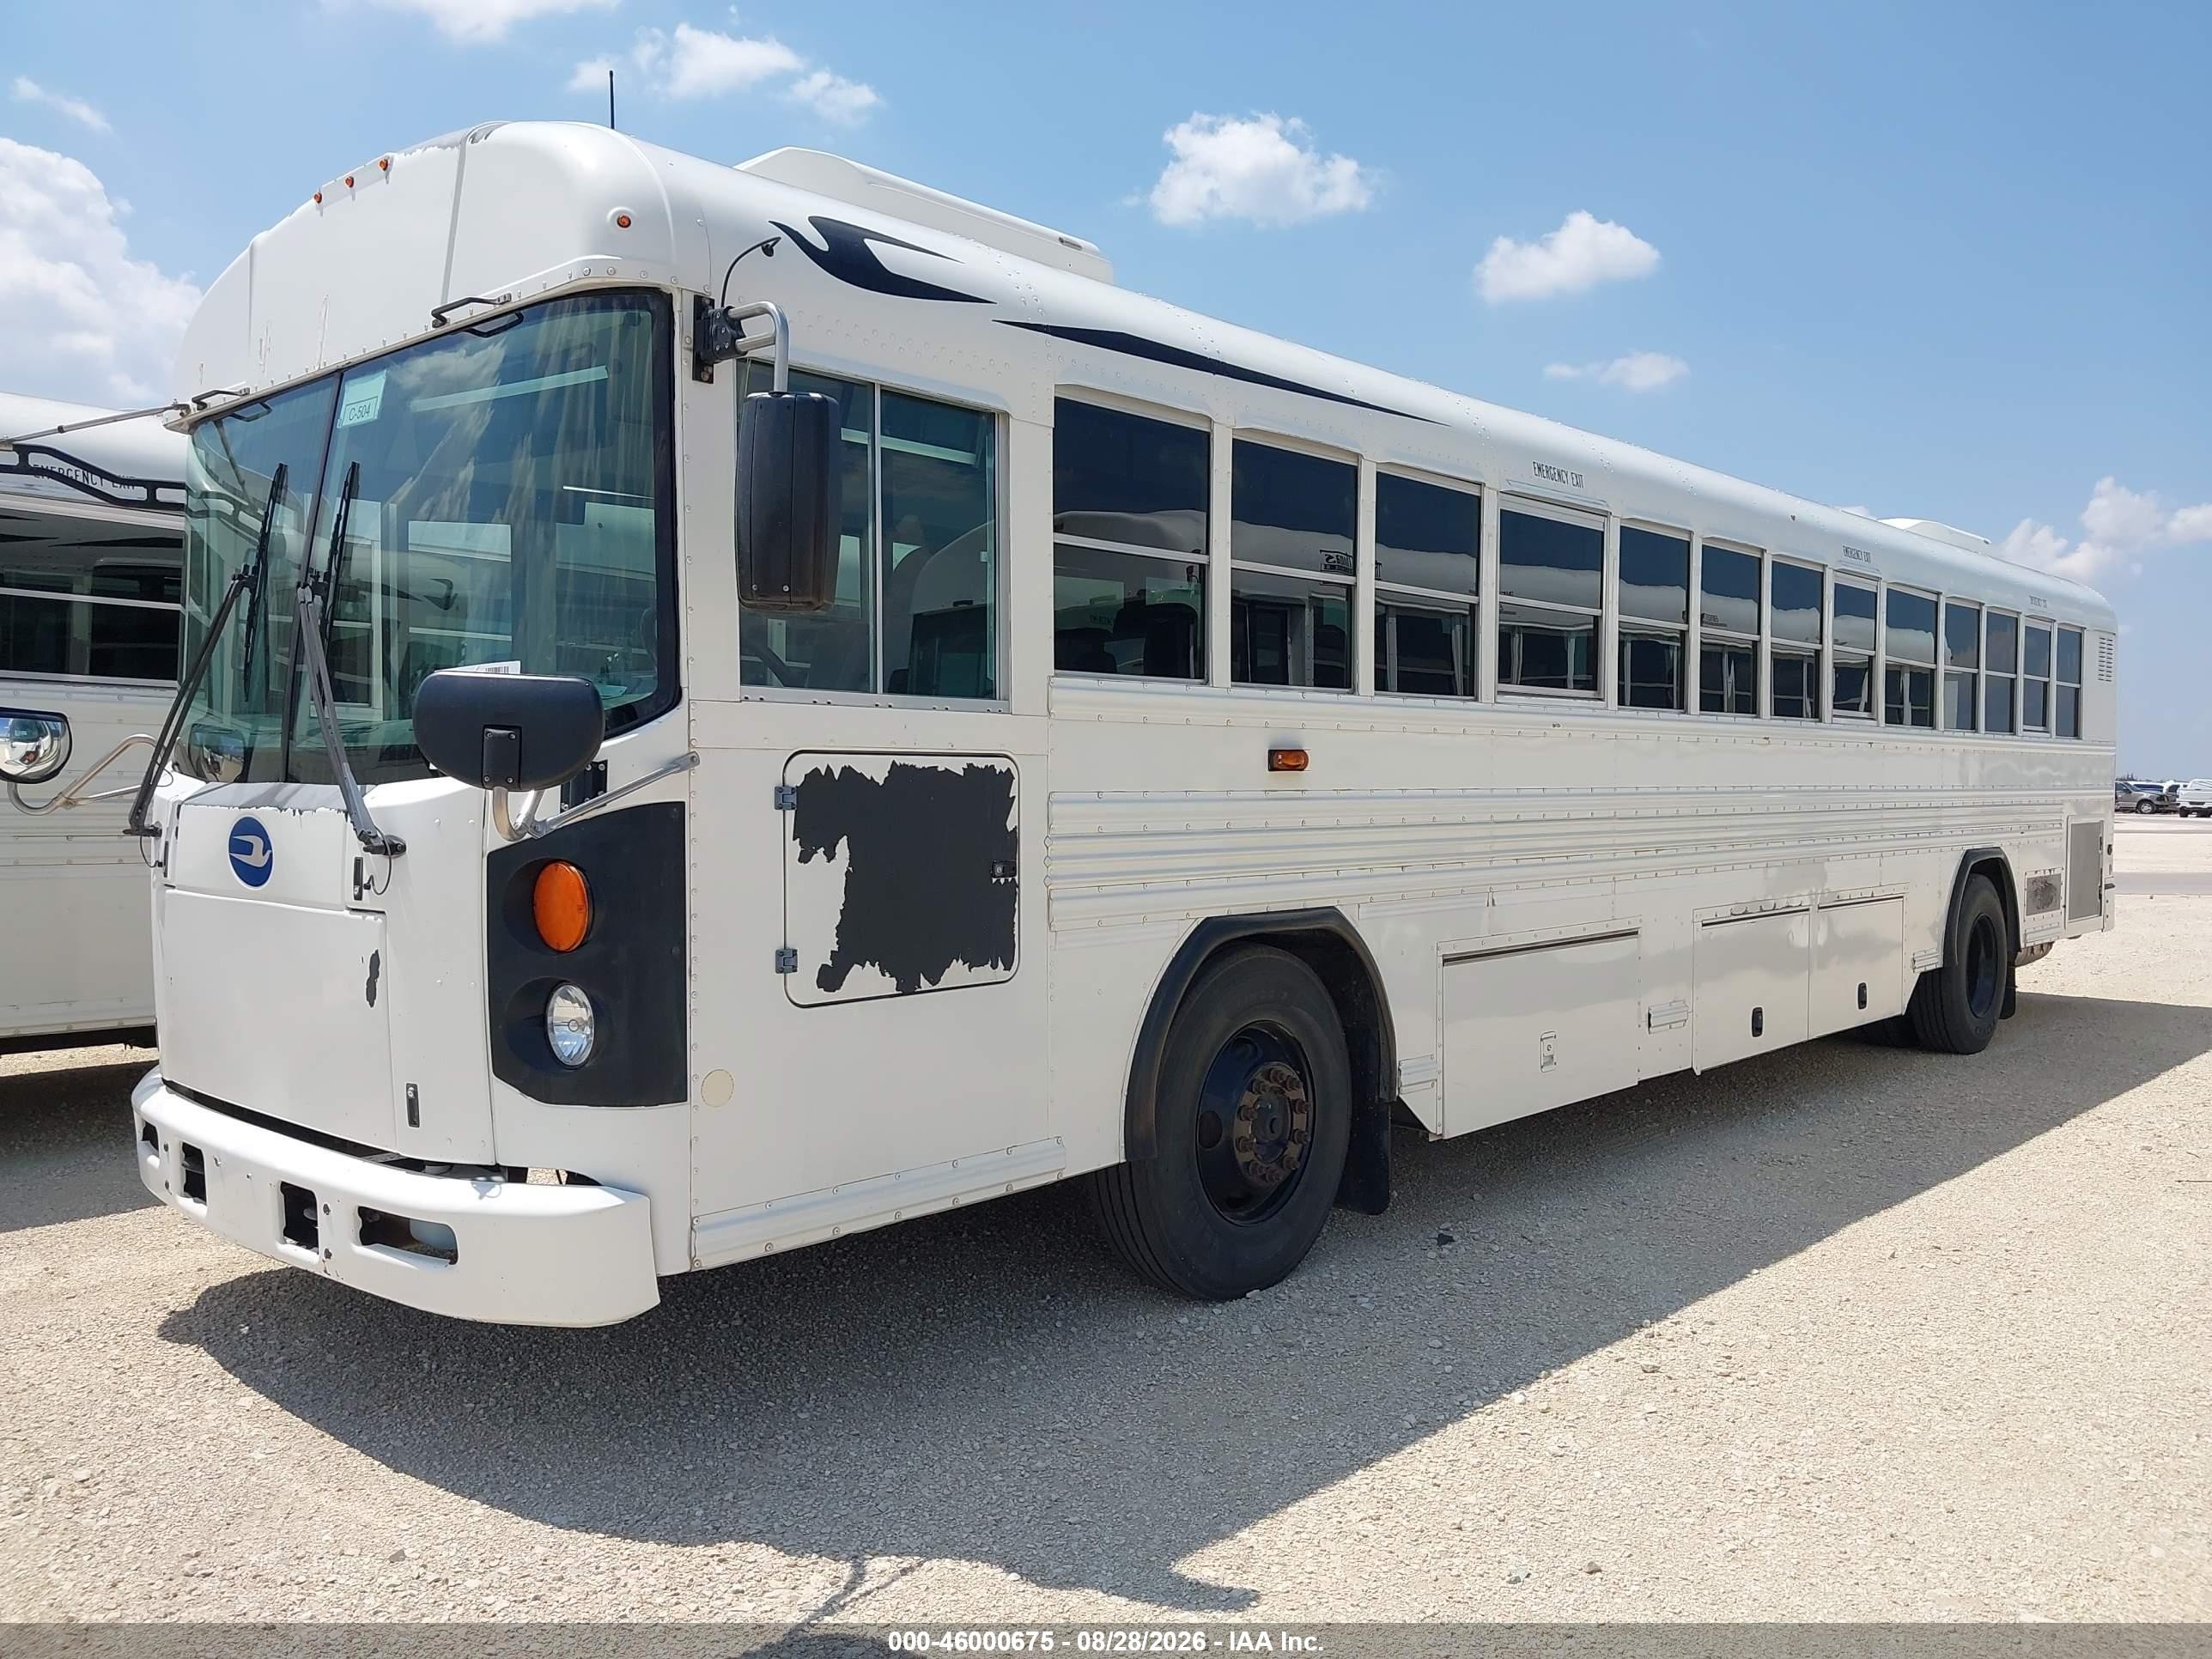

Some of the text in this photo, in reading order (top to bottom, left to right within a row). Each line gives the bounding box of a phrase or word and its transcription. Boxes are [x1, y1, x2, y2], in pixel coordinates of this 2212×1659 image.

[349, 403, 371, 421] C-504
[1533, 461, 1584, 489] EMERGENCY EXIT
